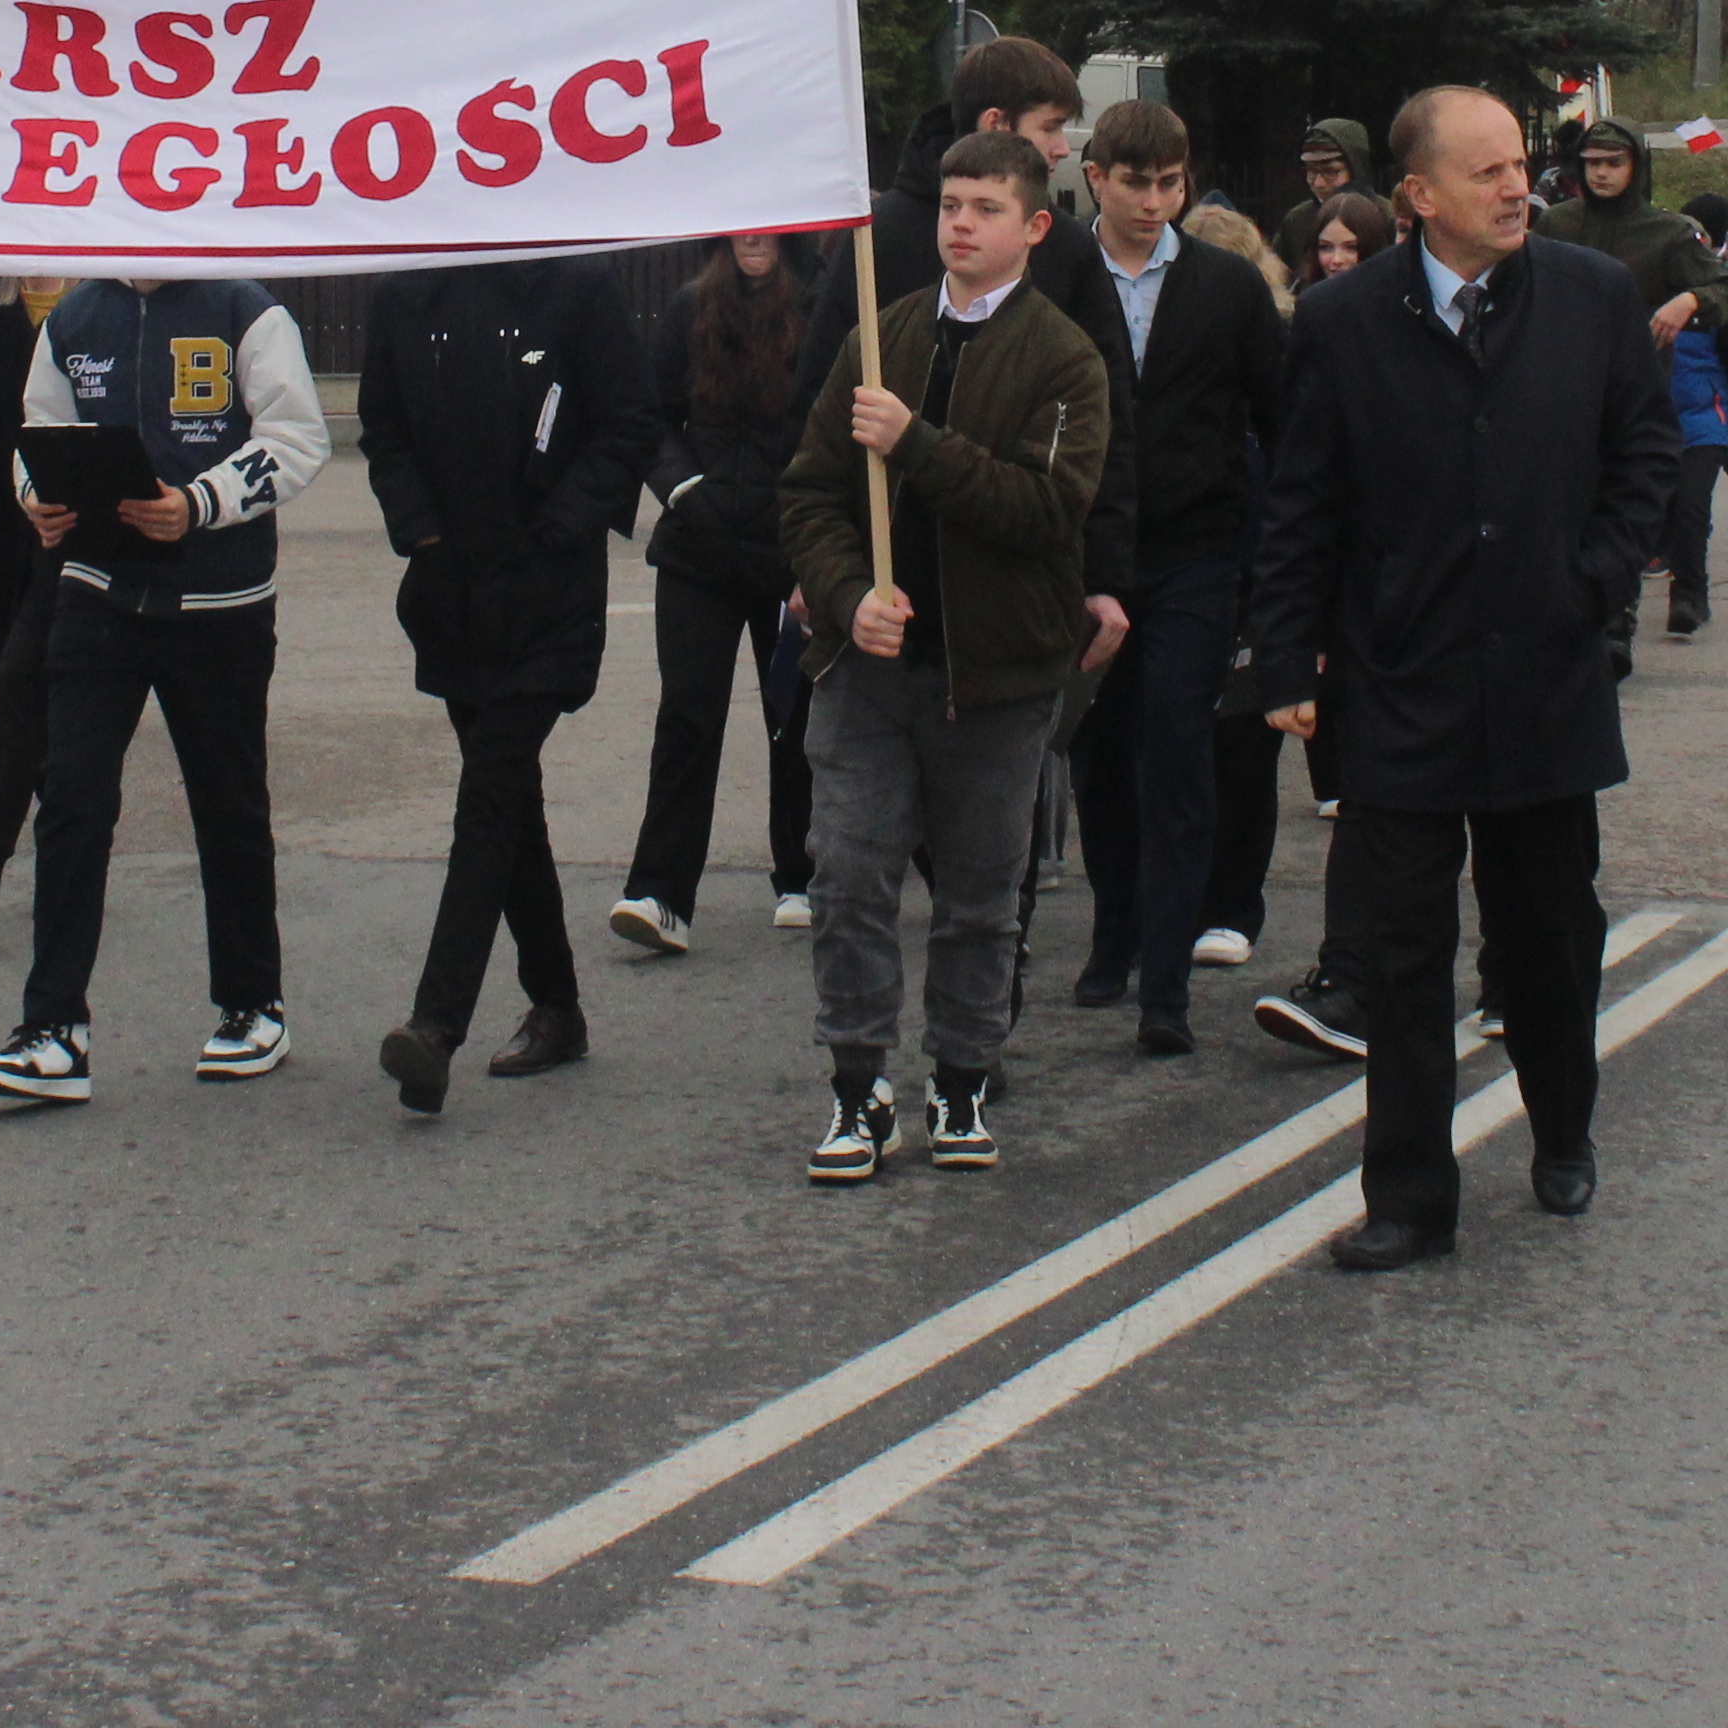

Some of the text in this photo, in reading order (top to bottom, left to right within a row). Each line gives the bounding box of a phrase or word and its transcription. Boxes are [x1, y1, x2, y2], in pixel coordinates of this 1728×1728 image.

[66, 353, 116, 379] Finest
[521, 350, 546, 365] 4F
[80, 375, 102, 387] TEAM
[170, 336, 233, 417] B
